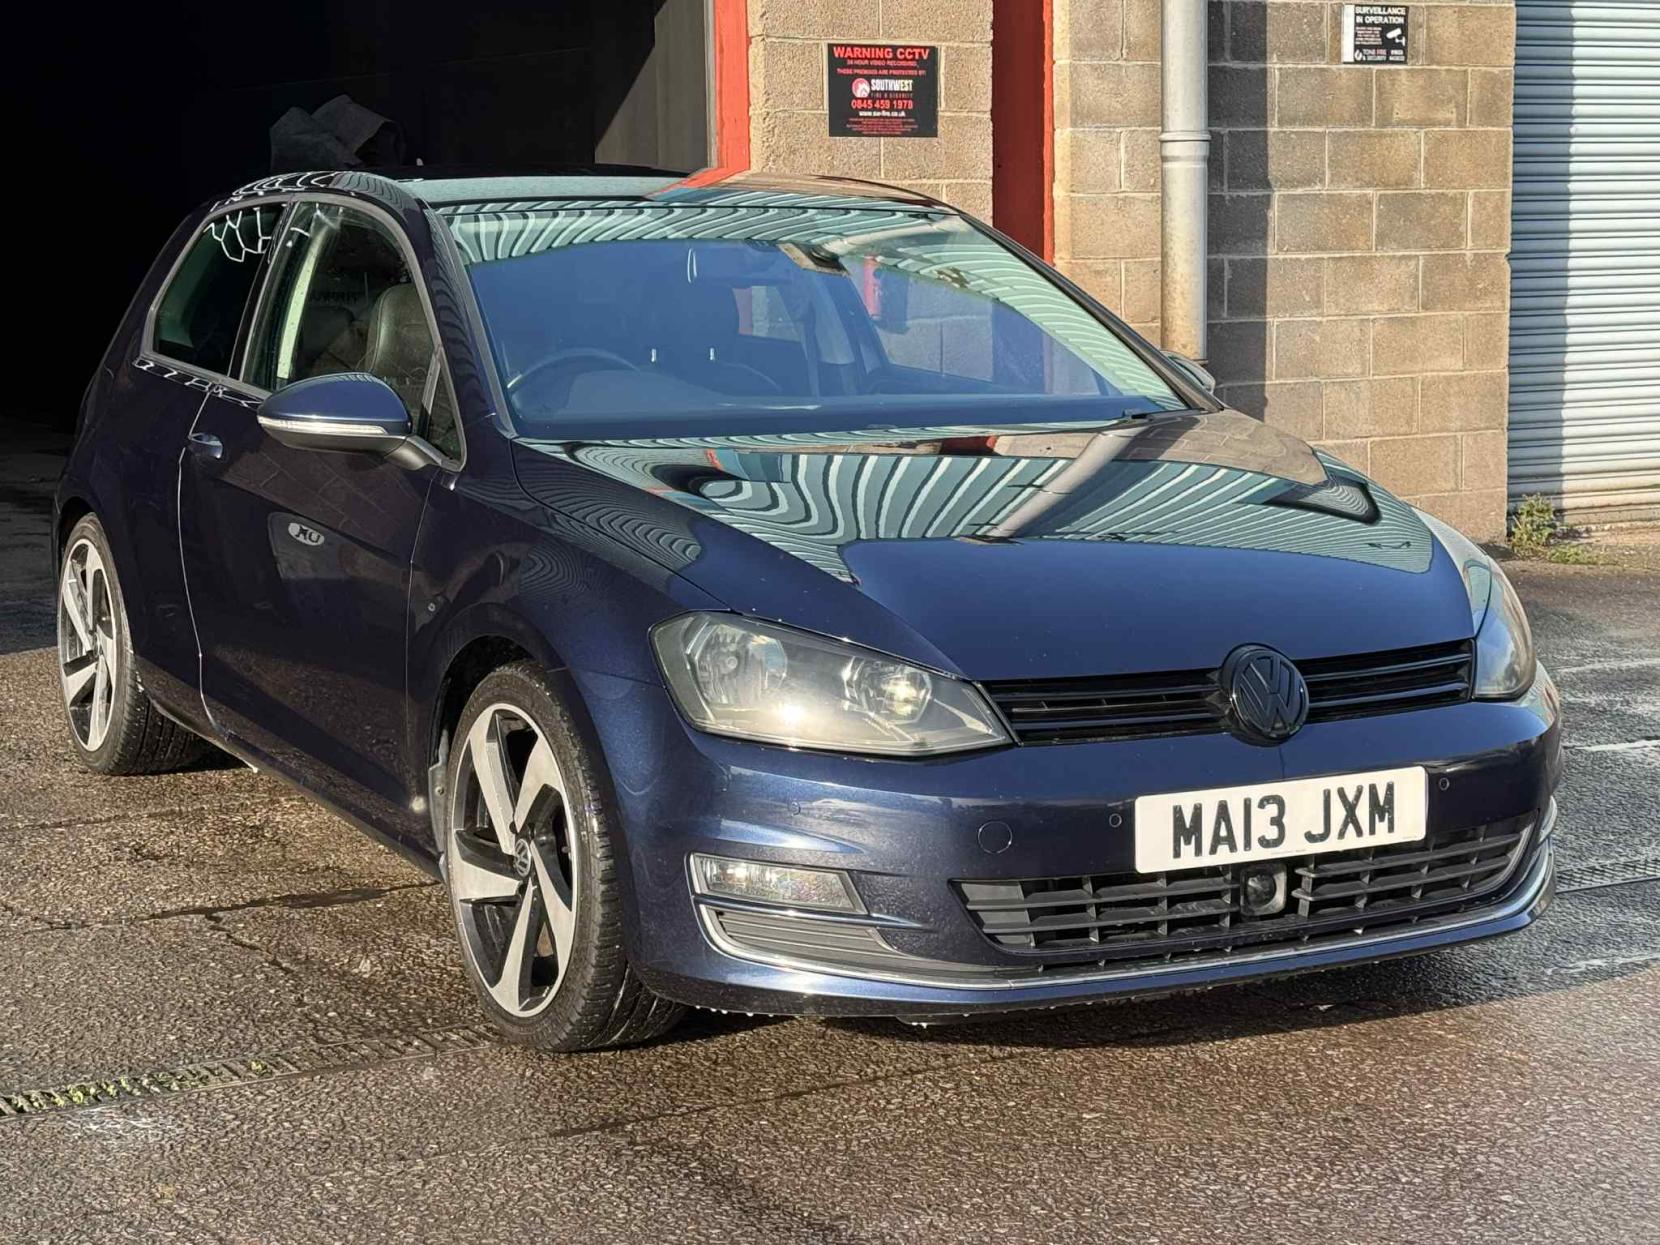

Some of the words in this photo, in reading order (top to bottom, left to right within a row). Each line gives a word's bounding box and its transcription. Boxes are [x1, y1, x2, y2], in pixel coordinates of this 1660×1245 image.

[1355, 6, 1406, 15] SURVEILLANCE
[1355, 15, 1363, 23] IN
[1365, 16, 1405, 24] OPERATION
[833, 46, 893, 59] WARNING
[896, 48, 930, 60] CCTV
[870, 79, 914, 91] SOUTHWEST
[851, 99, 873, 109] 0845
[874, 99, 891, 109] 459
[1172, 794, 1286, 859] MA13
[1303, 781, 1395, 844] JXM
